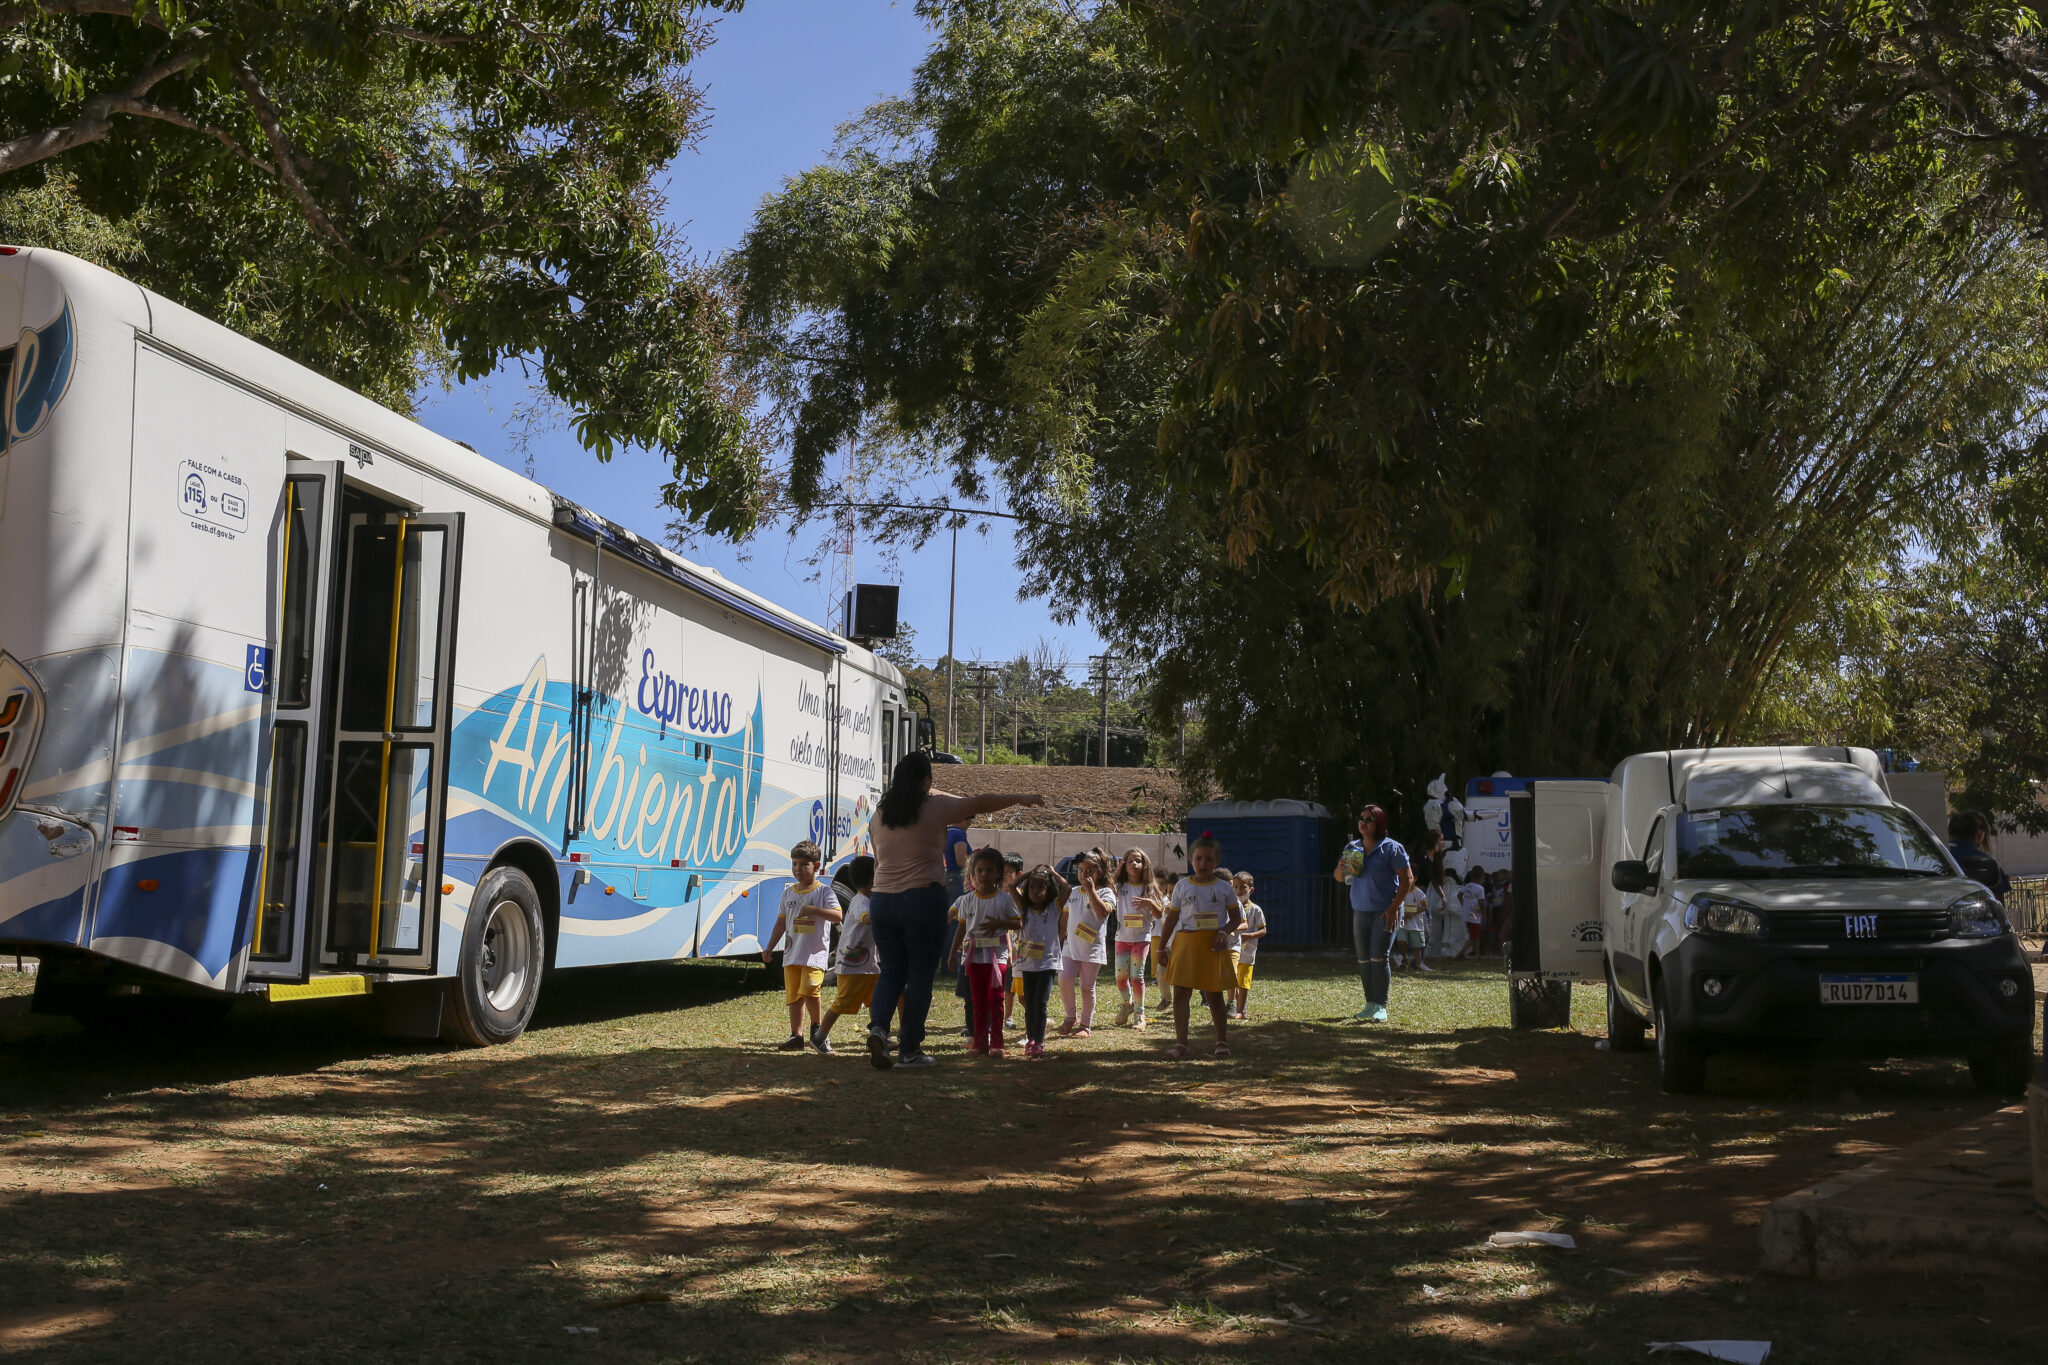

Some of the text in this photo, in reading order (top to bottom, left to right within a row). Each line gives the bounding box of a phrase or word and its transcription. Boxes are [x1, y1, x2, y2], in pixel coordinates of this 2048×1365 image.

[188, 459, 242, 485] FALE COM A CAESB
[188, 487, 202, 503] 115
[211, 495, 218, 503] ou
[190, 521, 236, 541] caesb.df.gov.br
[637, 647, 733, 741] Expresso
[798, 678, 820, 718] Uma
[852, 704, 872, 739] pelo
[483, 653, 763, 867] Ambiental
[815, 736, 826, 769] do
[1845, 914, 1878, 938] FIAT
[1830, 984, 1907, 1001] RUD7D14
